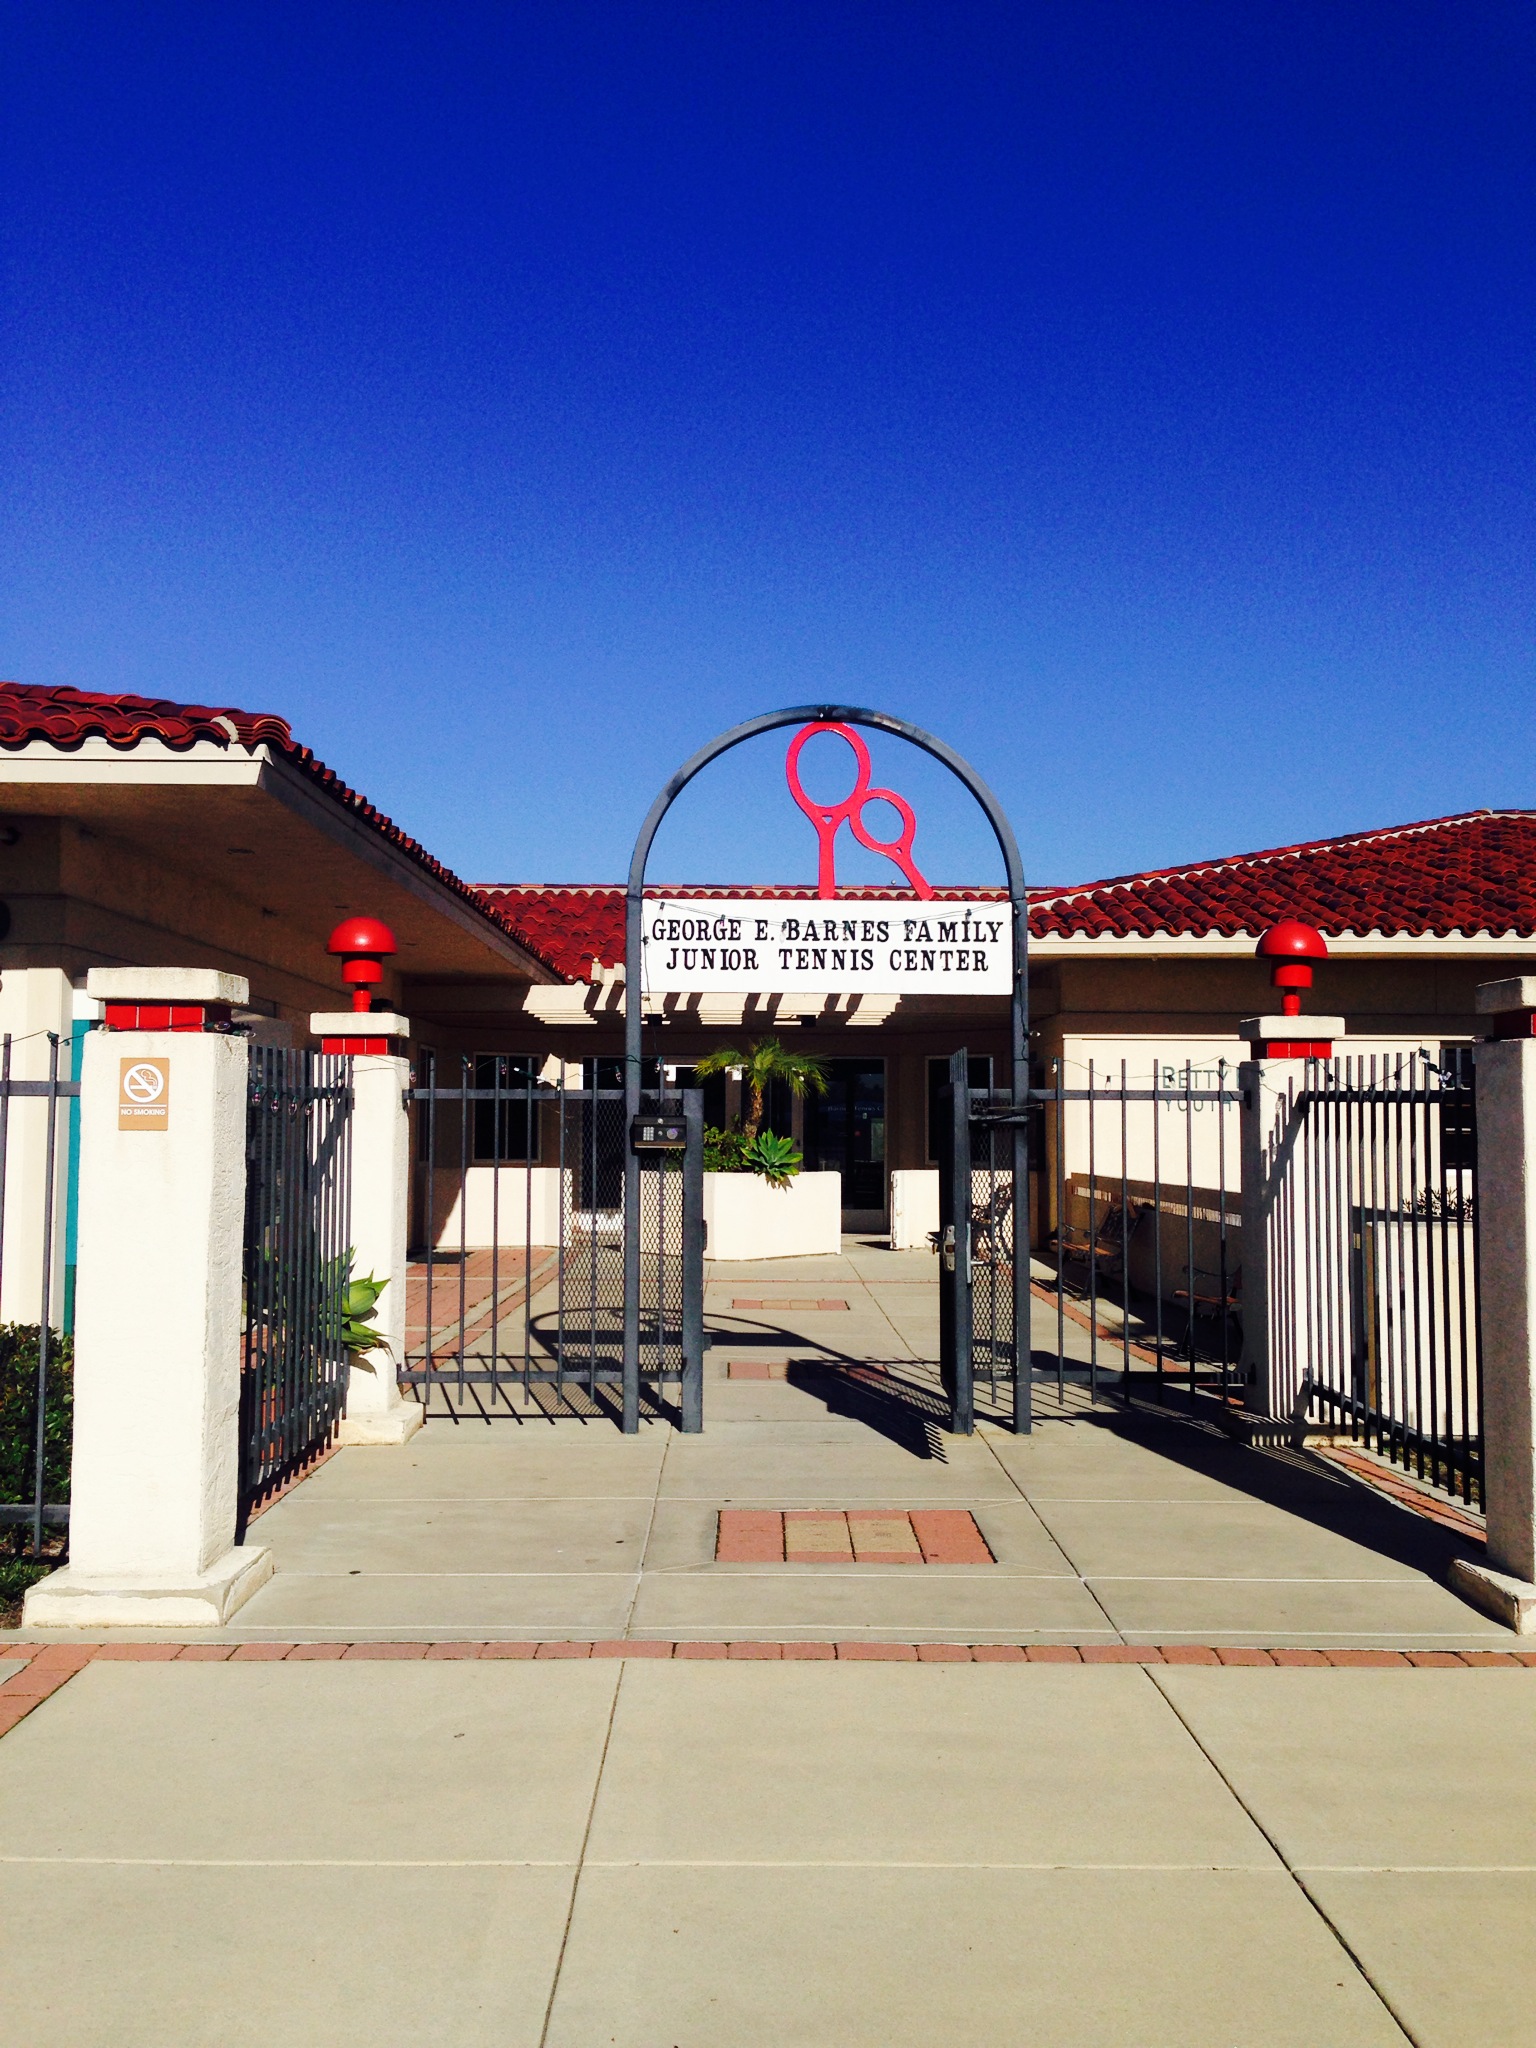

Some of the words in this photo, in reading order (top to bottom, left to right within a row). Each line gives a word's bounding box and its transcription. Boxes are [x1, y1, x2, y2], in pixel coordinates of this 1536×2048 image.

[652, 919, 741, 941] GEORGE
[755, 919, 775, 941] E.
[785, 919, 890, 942] BARNES
[903, 920, 1003, 943] FAMILY
[666, 948, 759, 970] JUNIOR
[779, 949, 874, 971] TENNIS
[890, 949, 989, 972] CENTER
[1162, 1066, 1228, 1089] BETTY
